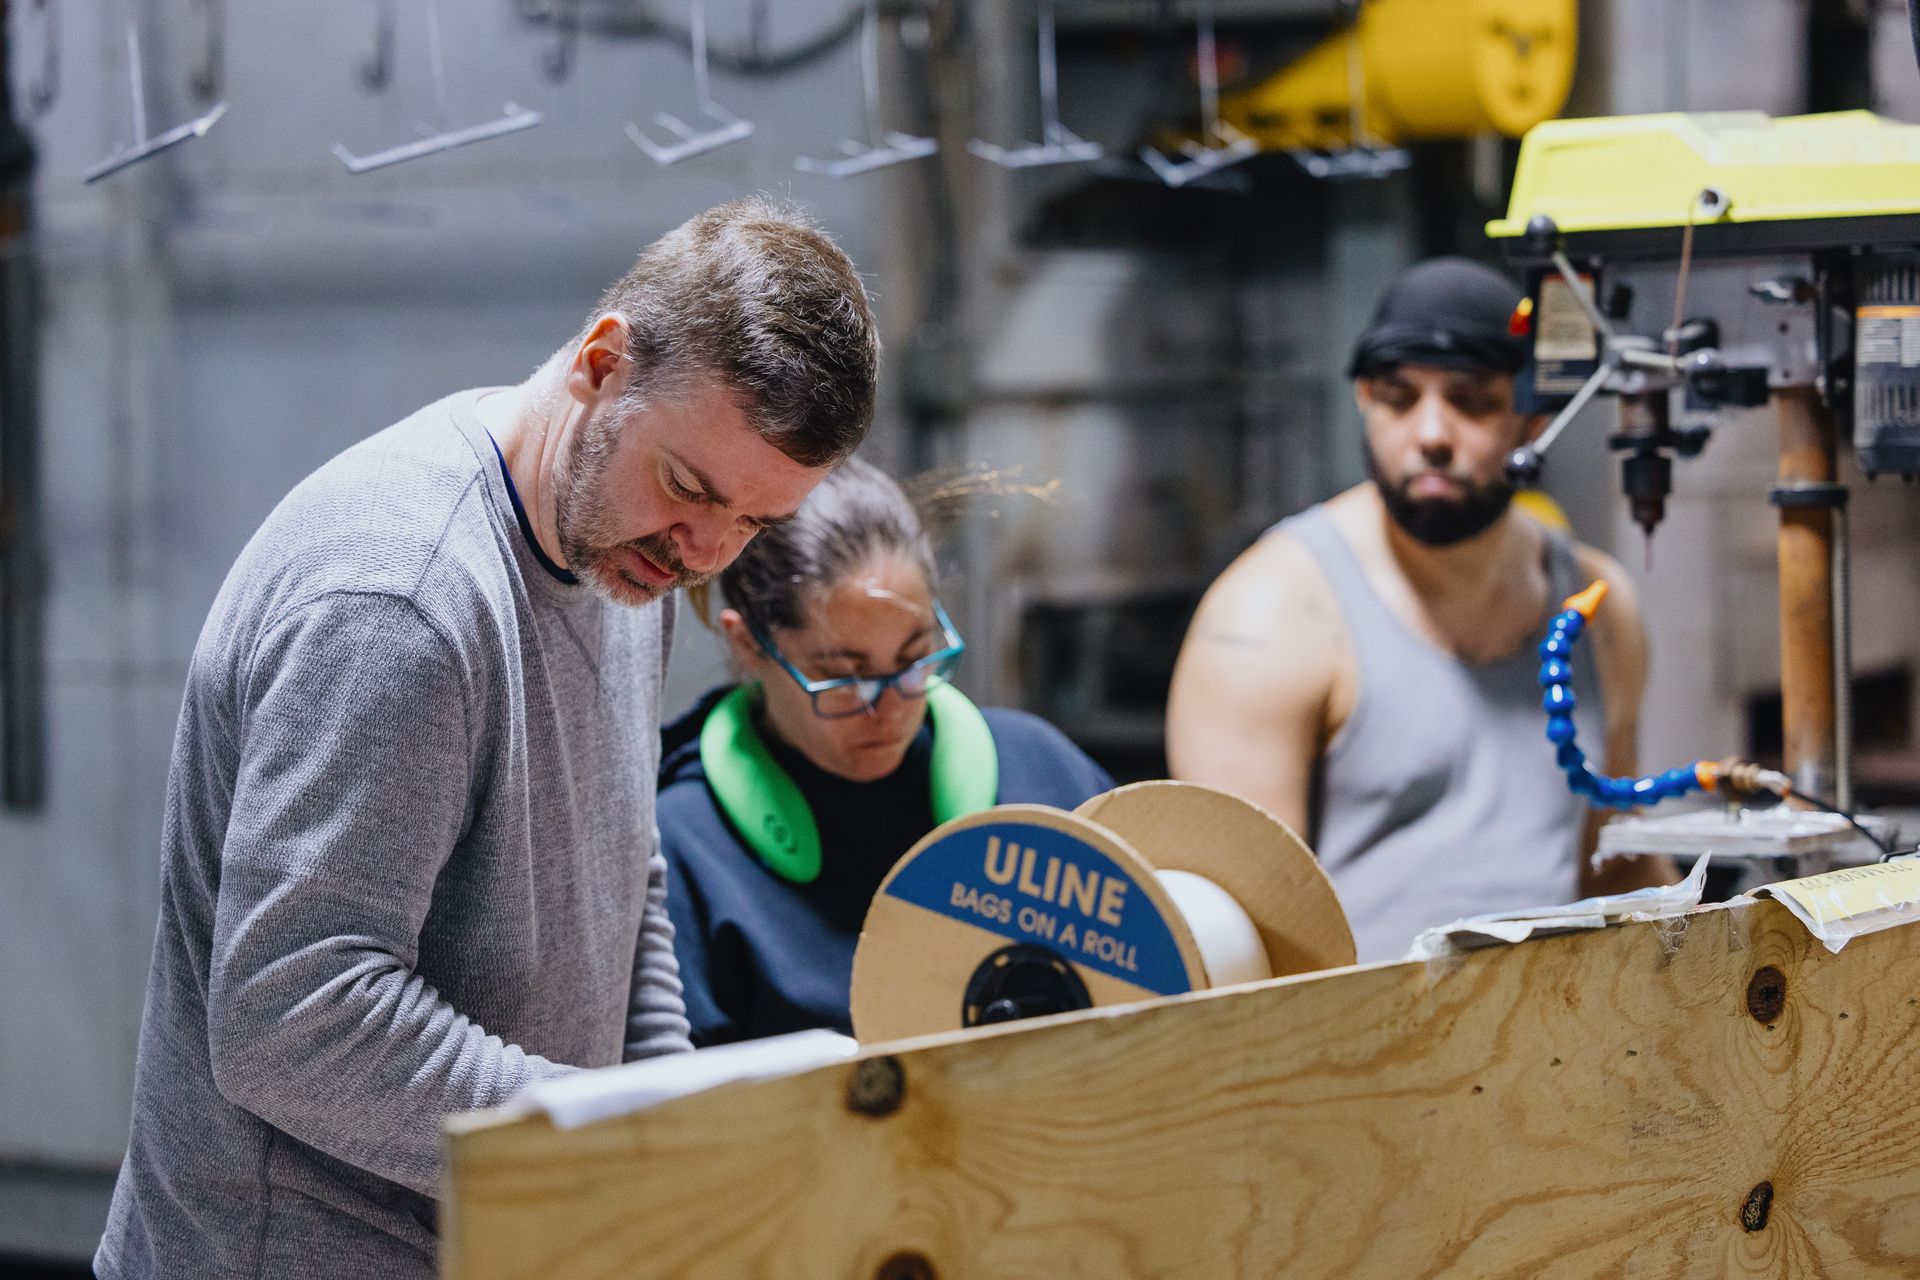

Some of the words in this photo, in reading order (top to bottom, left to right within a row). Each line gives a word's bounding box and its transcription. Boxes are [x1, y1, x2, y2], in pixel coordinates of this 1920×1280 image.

[984, 835, 1128, 927] ULINE
[950, 882, 1013, 925] BAGS
[1017, 906, 1057, 940] ON
[1058, 923, 1077, 948] A
[1082, 928, 1138, 972] ROLL
